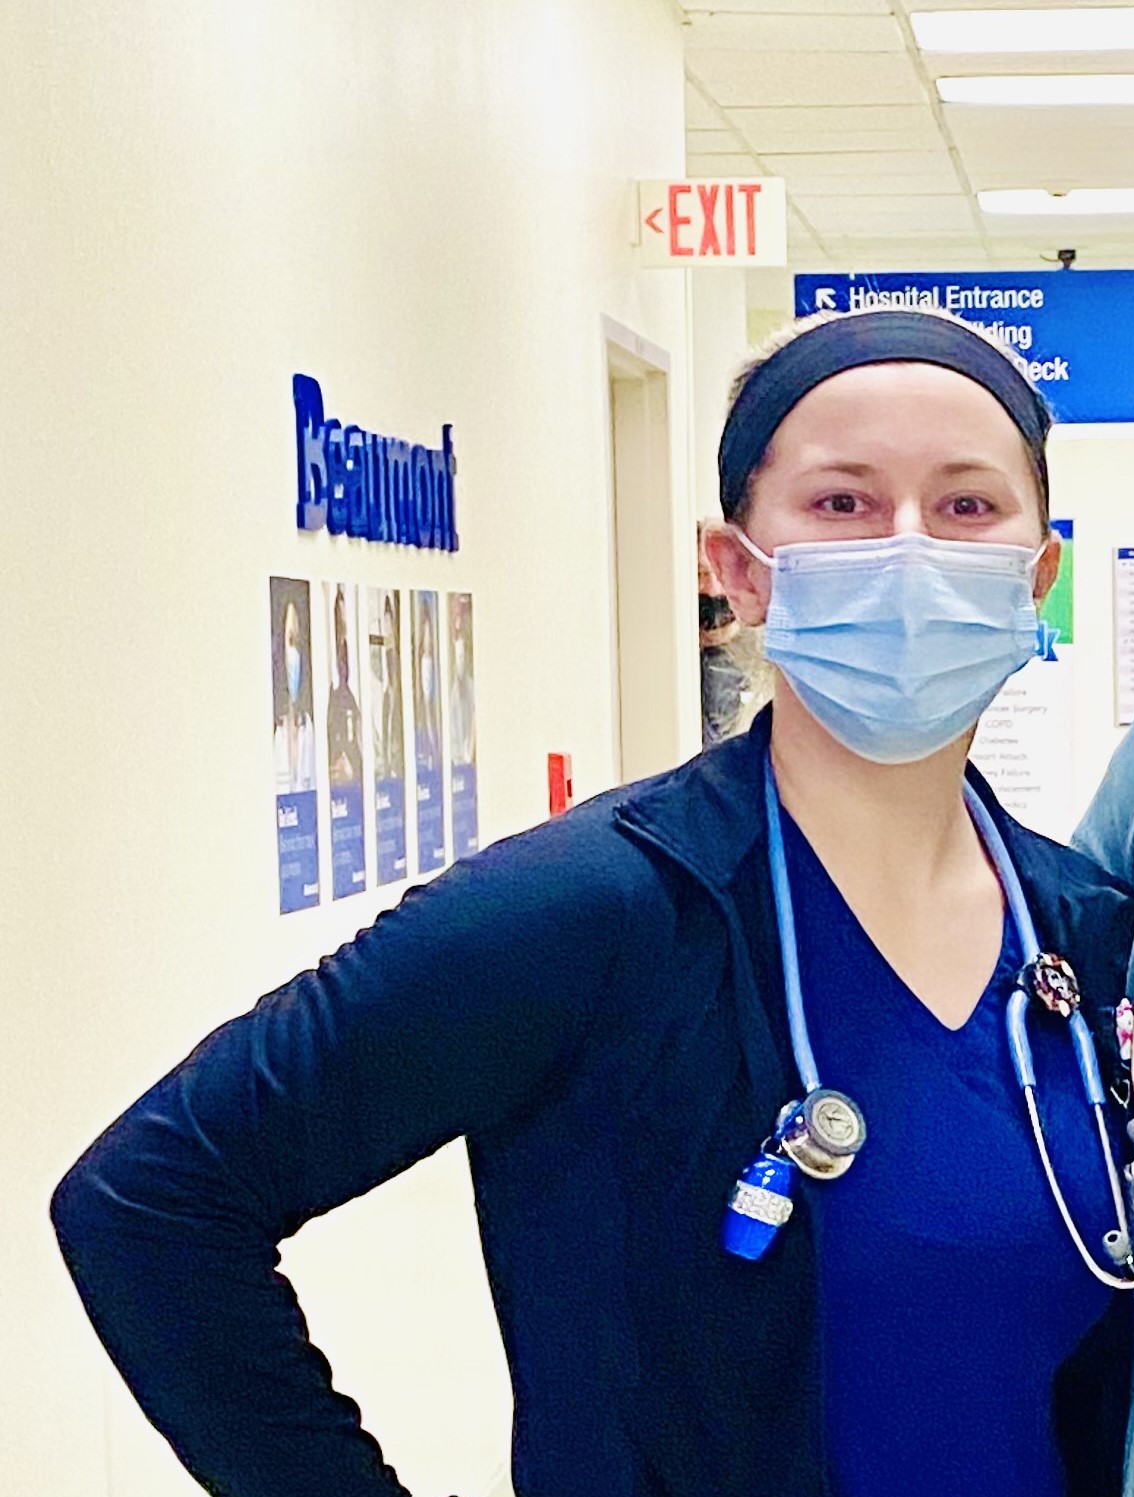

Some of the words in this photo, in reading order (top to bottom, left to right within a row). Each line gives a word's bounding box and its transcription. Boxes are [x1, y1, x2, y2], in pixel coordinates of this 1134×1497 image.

[668, 184, 762, 256] EXIT
[850, 286, 939, 309] Hospital
[946, 286, 1044, 309] Entrance
[292, 373, 459, 552] Beaumont
